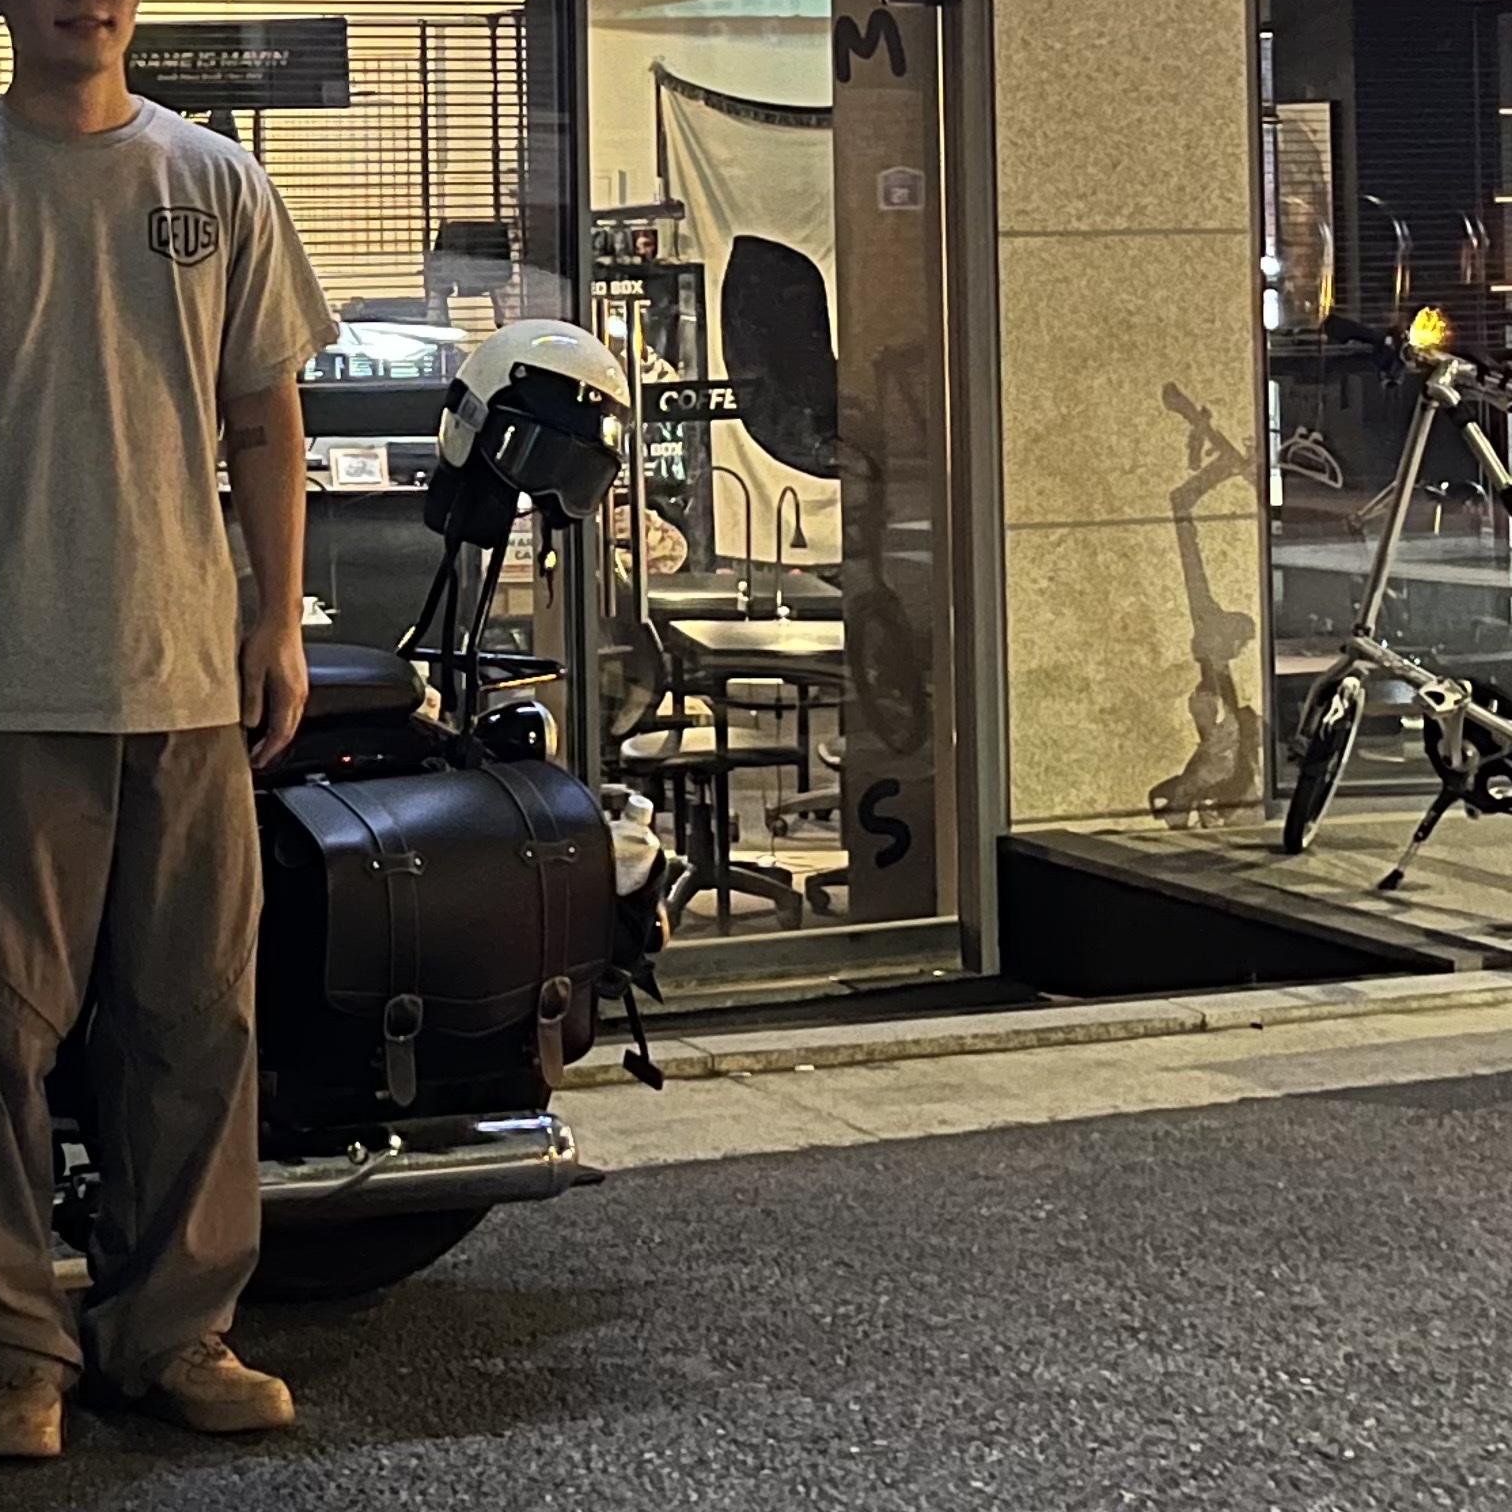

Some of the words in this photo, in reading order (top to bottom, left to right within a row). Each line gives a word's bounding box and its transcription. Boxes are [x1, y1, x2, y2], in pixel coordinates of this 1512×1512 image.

[833, 8, 906, 83] M
[157, 214, 213, 257] DEUS
[610, 279, 644, 296] BOX
[858, 777, 912, 869] S
